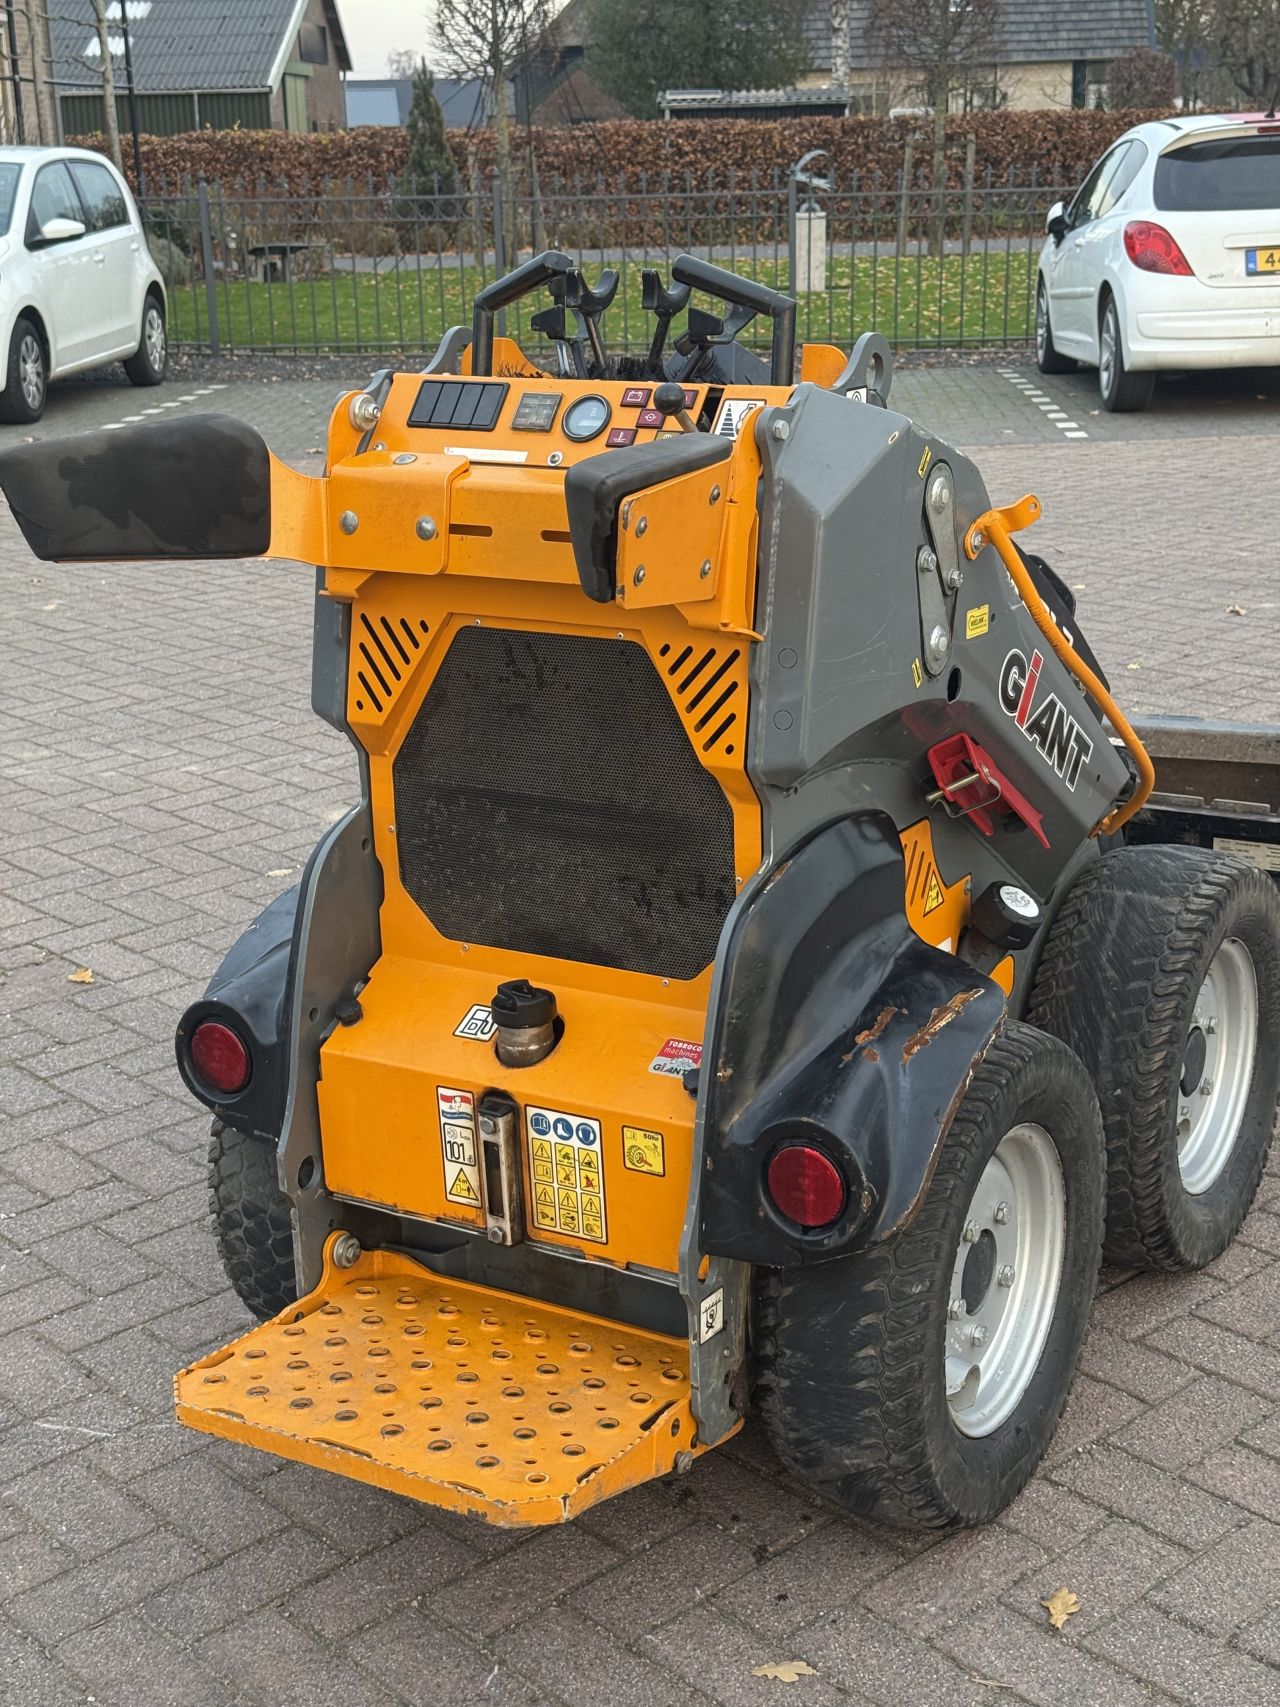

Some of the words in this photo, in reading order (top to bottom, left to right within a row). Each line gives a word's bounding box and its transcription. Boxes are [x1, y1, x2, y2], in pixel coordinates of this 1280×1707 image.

[668, 1040, 702, 1051] TOBROCO
[664, 1047, 698, 1058] machines
[447, 1140, 465, 1161] 101
